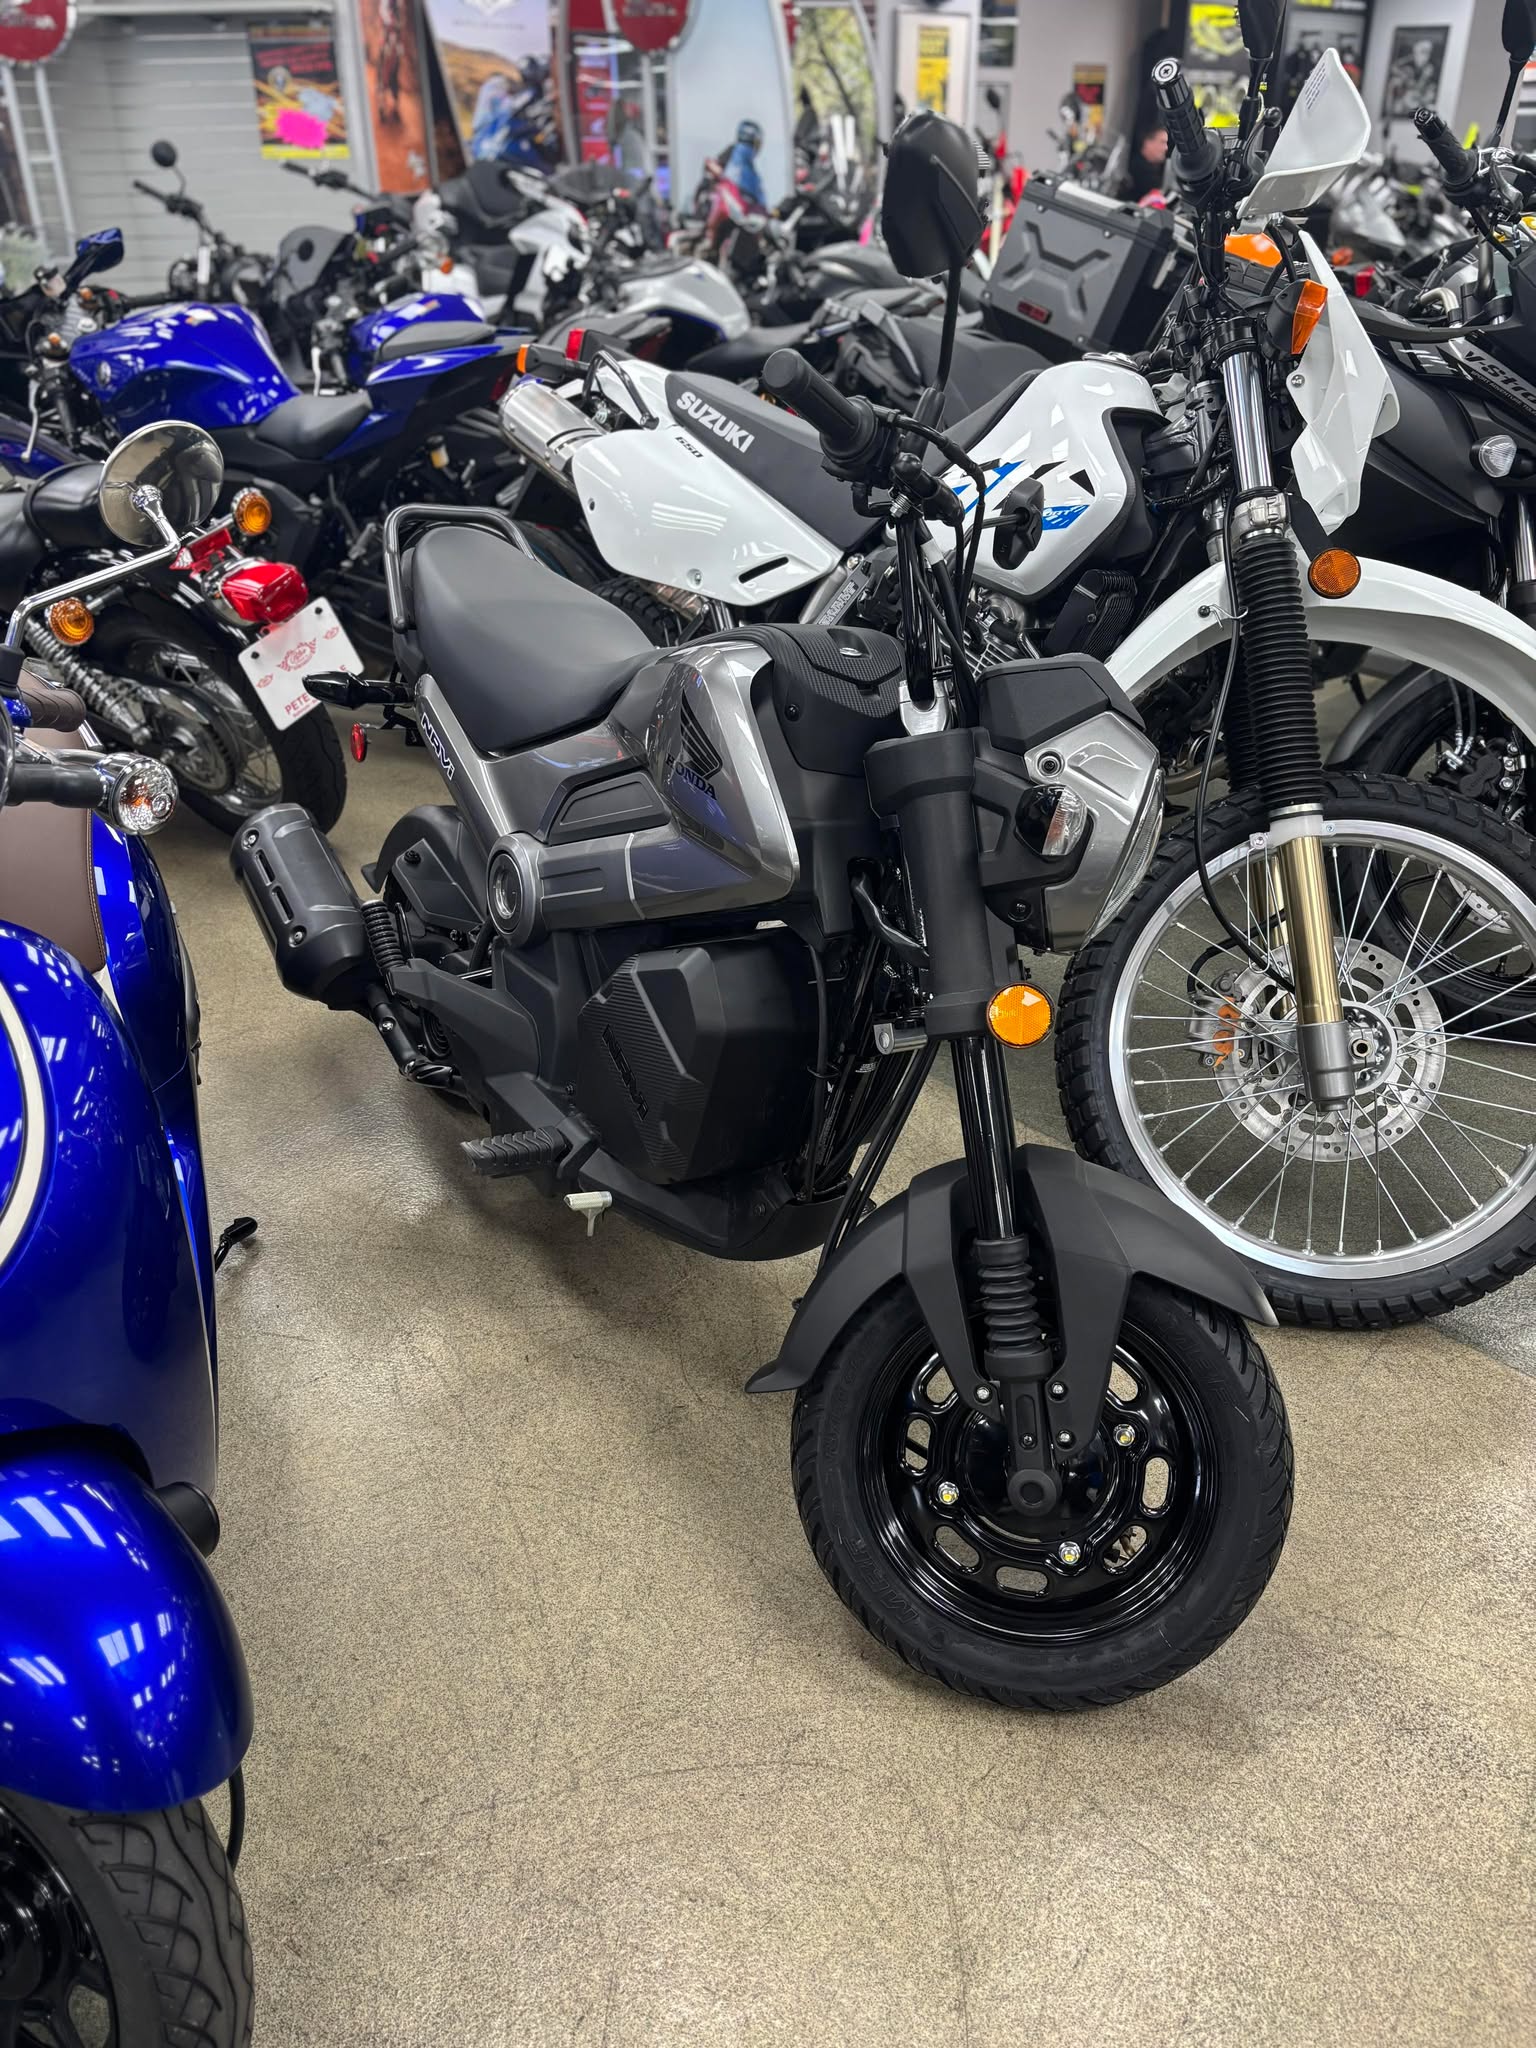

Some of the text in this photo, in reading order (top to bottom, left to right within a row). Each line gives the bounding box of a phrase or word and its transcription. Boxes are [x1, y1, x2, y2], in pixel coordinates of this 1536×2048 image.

[676, 391, 755, 453] SUZUKI
[675, 436, 704, 458] 650
[666, 753, 717, 800] HONDA
